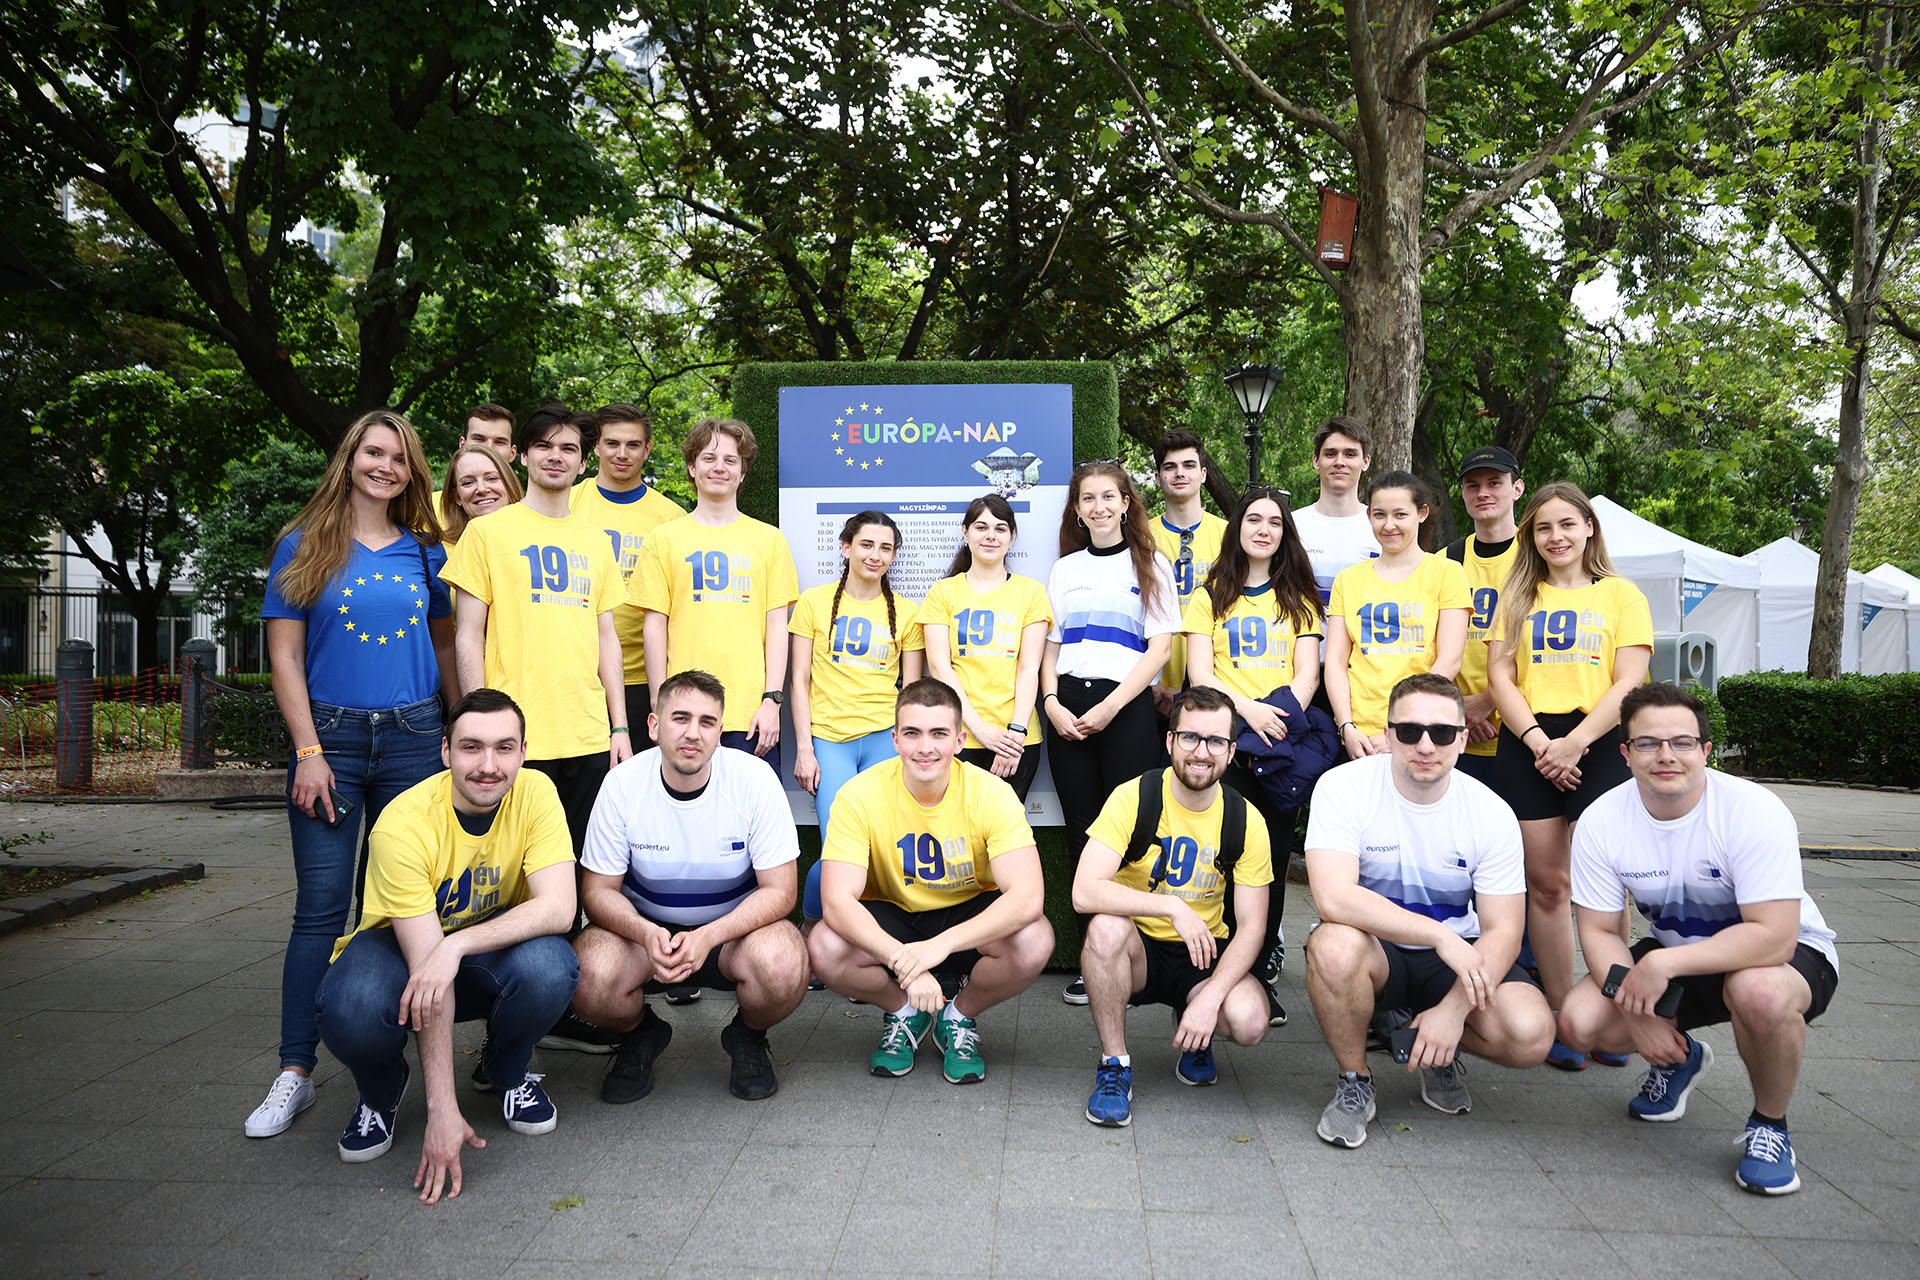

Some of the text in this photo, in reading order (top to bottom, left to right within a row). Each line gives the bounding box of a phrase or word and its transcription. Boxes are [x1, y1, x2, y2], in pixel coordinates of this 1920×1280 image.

[848, 416, 1017, 444] EURÓPA-NAP
[622, 532, 643, 549] év
[520, 544, 589, 593] 19 év
[685, 550, 751, 591] 19 év
[570, 571, 591, 596] km
[730, 571, 750, 592] km
[1468, 588, 1499, 629] 9
[954, 608, 994, 646] 19
[1356, 600, 1424, 644] 19 év
[1401, 622, 1425, 642] km
[1526, 608, 1605, 651] 19 év
[833, 616, 872, 656] 19
[995, 627, 1016, 648] km
[1222, 616, 1267, 658] 19
[1268, 635, 1288, 656] km
[1578, 627, 1602, 652] km
[869, 640, 890, 660] km
[896, 832, 967, 881] 19 év
[473, 861, 501, 886] év
[946, 861, 974, 881] km
[1192, 866, 1220, 890] km
[471, 889, 500, 913] km
